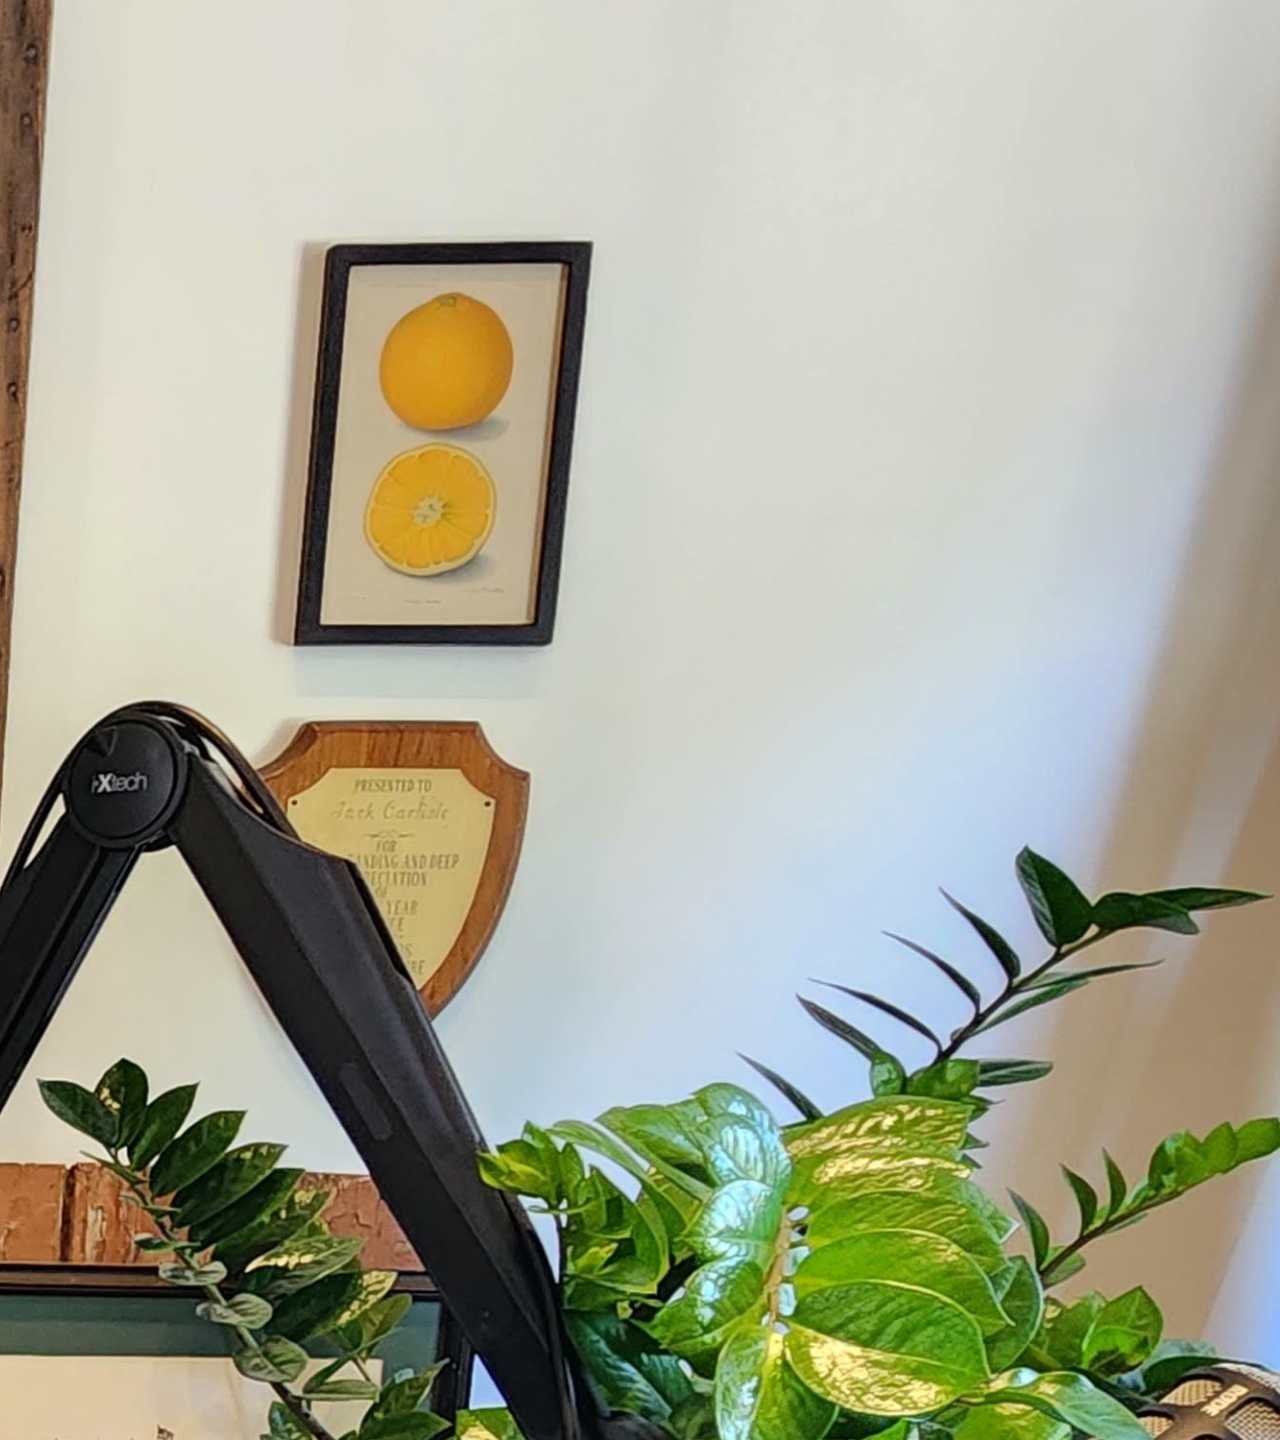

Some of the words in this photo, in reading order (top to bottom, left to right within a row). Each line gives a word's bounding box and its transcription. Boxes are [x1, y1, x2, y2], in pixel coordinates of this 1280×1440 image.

[354, 778, 415, 794] PRESENTED
[418, 778, 433, 793] TO
[404, 854, 429, 870] AND
[430, 854, 460, 870] DEEP
